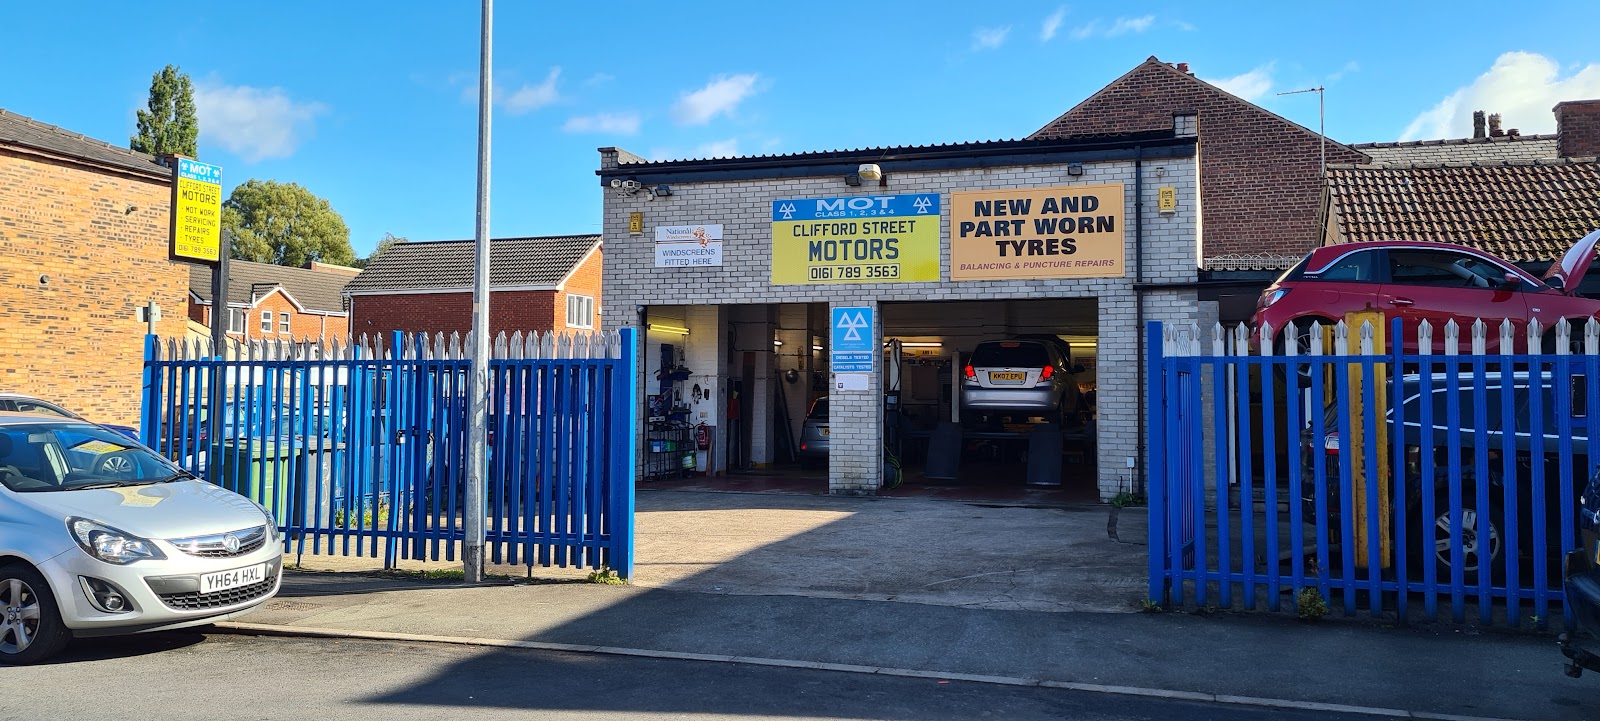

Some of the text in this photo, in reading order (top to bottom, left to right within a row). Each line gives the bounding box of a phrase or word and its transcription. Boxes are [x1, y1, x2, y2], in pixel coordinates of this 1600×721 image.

[190, 163, 212, 176] MOT
[180, 180, 220, 195] CLIFFORD STREET
[182, 190, 216, 205] MOTORS
[817, 196, 895, 211] MOT
[200, 208, 215, 217] WORK
[975, 195, 1099, 217] NEW AND
[186, 216, 215, 226] SERVICING
[793, 220, 916, 237] CLIFFORD STREET
[960, 216, 1114, 238] PART WORN
[185, 225, 210, 235] REPAIRS
[185, 234, 204, 244] TYRES
[203, 247, 216, 256] 3563
[809, 238, 898, 262] MOTORS
[996, 238, 1077, 256] TYRES
[811, 266, 898, 279] 0161 789 3563
[960, 262, 1011, 270] BALANCING
[1023, 260, 1072, 268] PUNCTURE
[207, 568, 260, 589] YH64 HXL
